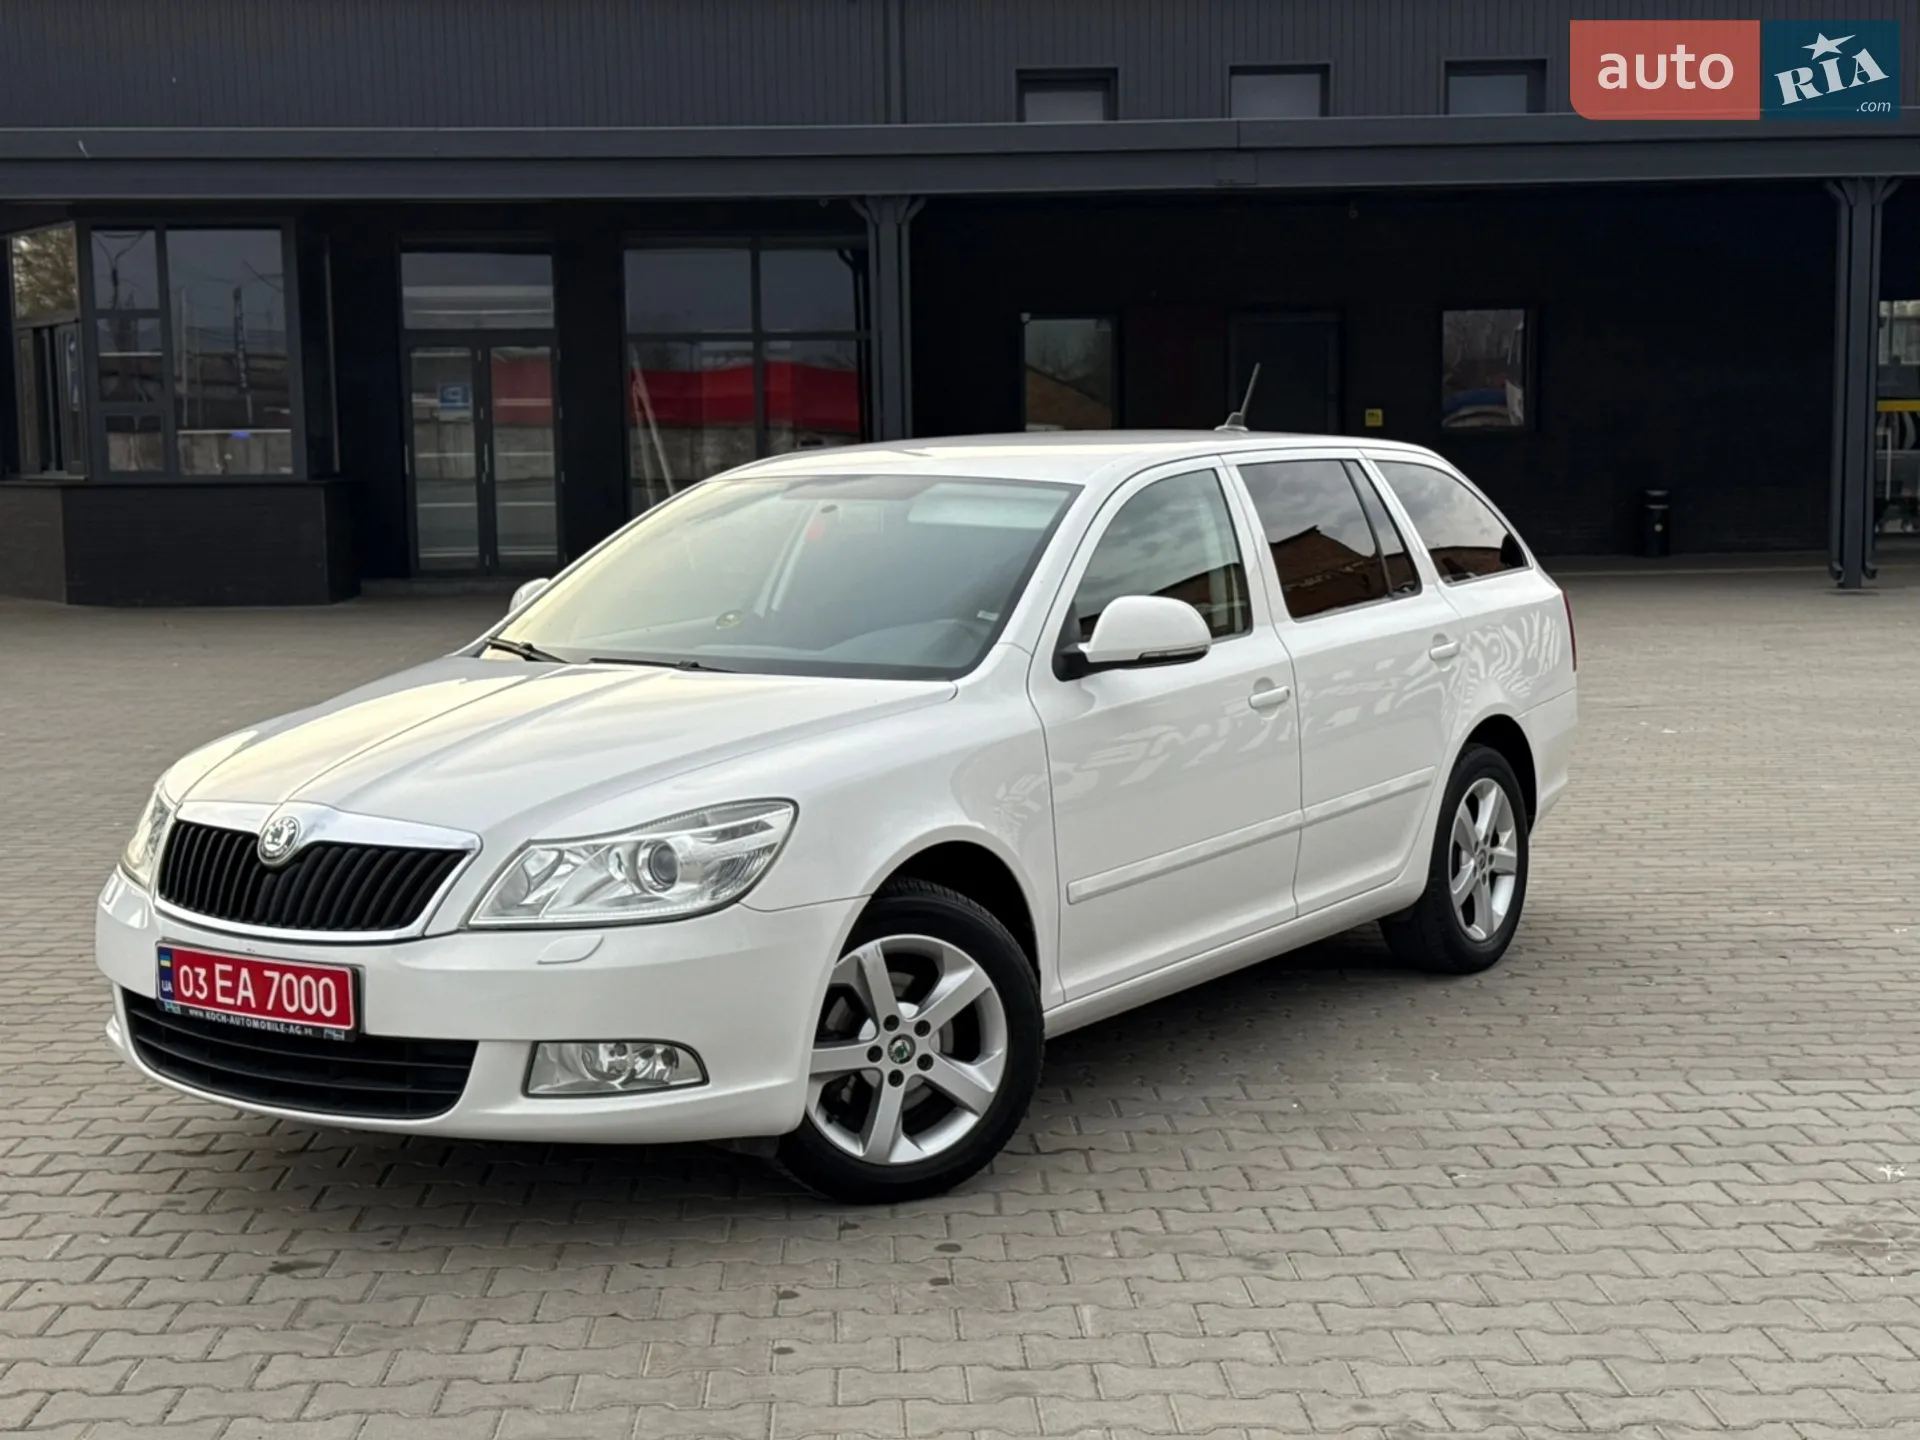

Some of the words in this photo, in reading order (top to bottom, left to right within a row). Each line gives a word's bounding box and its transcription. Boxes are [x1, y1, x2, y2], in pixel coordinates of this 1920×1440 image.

[161, 980, 174, 993] UA
[178, 964, 208, 1000] 03
[214, 963, 256, 1009] EA
[263, 970, 337, 1018] 7000
